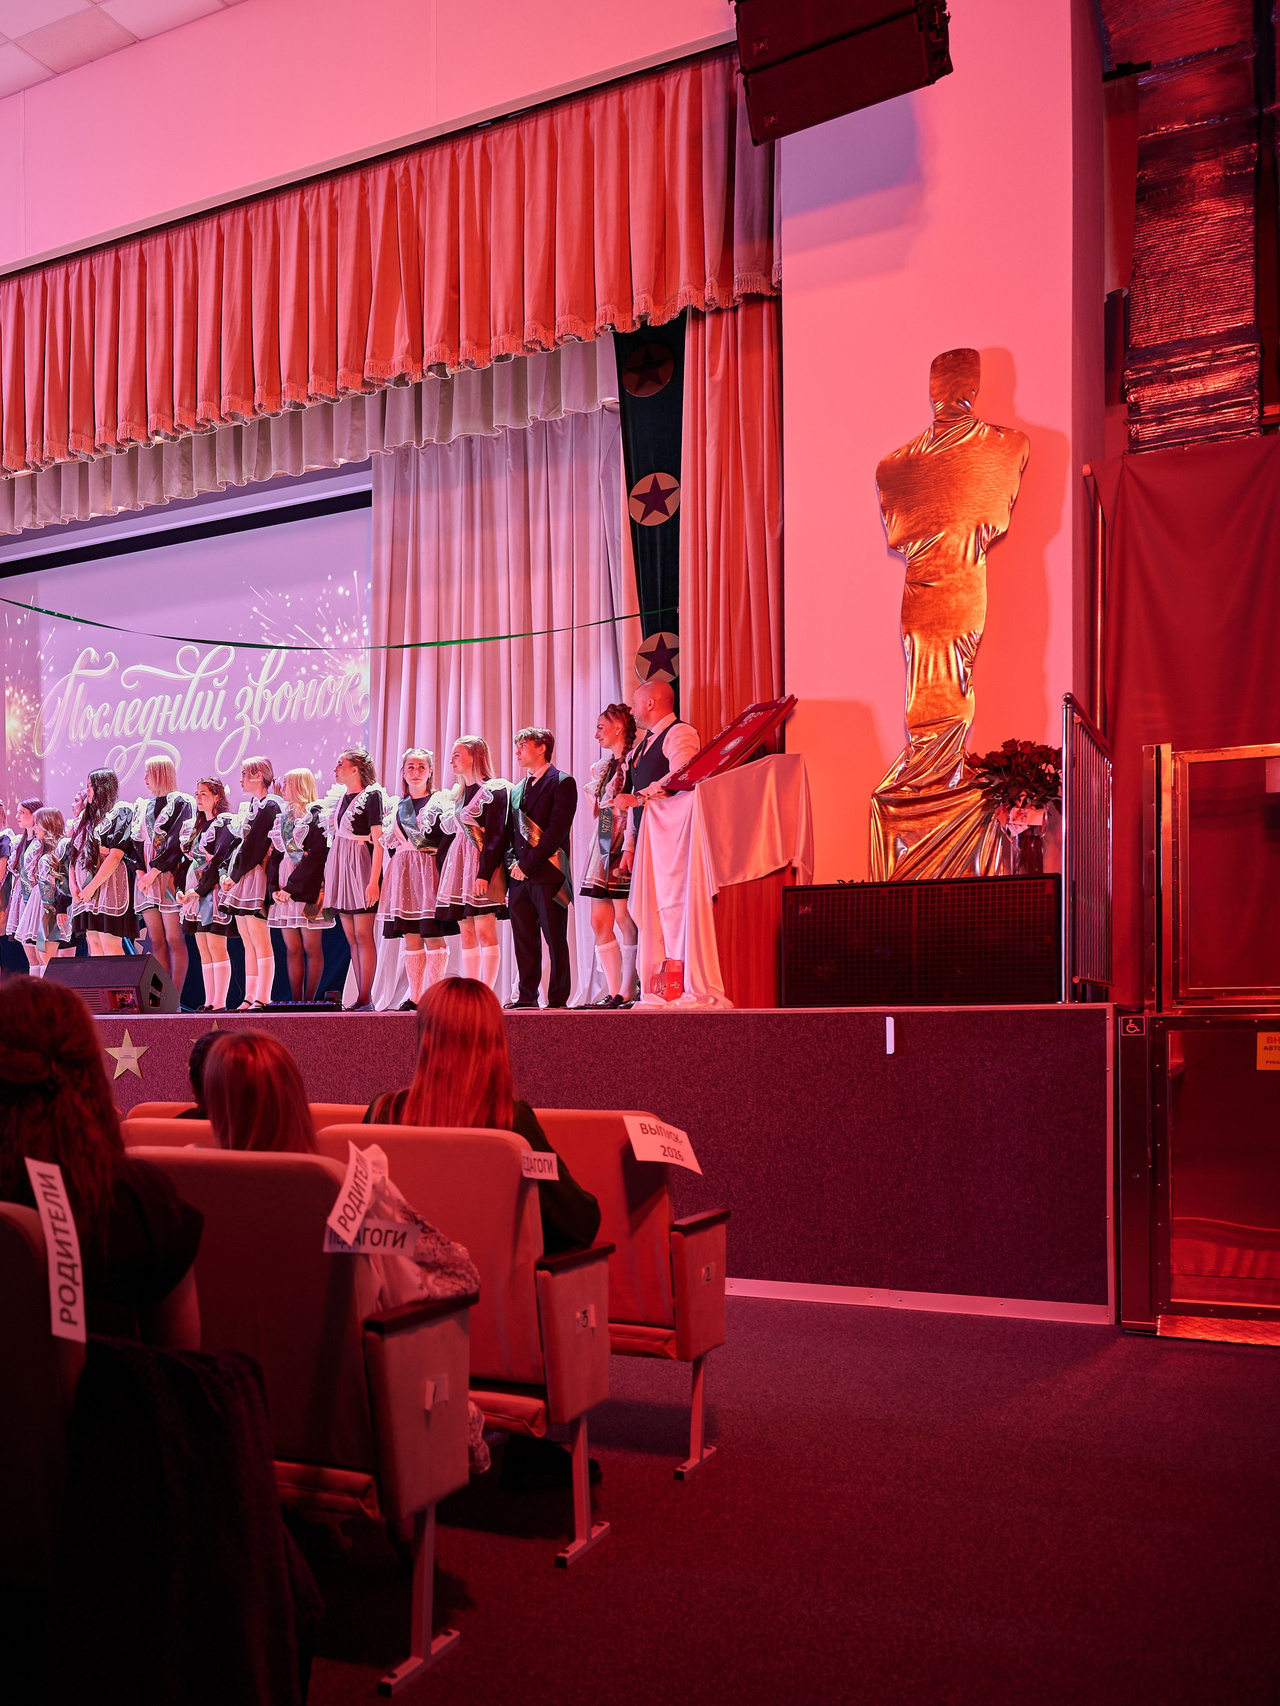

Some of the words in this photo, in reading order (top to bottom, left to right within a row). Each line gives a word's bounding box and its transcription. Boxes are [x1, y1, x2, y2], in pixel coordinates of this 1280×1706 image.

[33, 644, 235, 786] Последний
[215, 643, 370, 776] звонок
[660, 1145, 684, 1162] 2026
[36, 1171, 80, 1326] РОДИТЕЛИ
